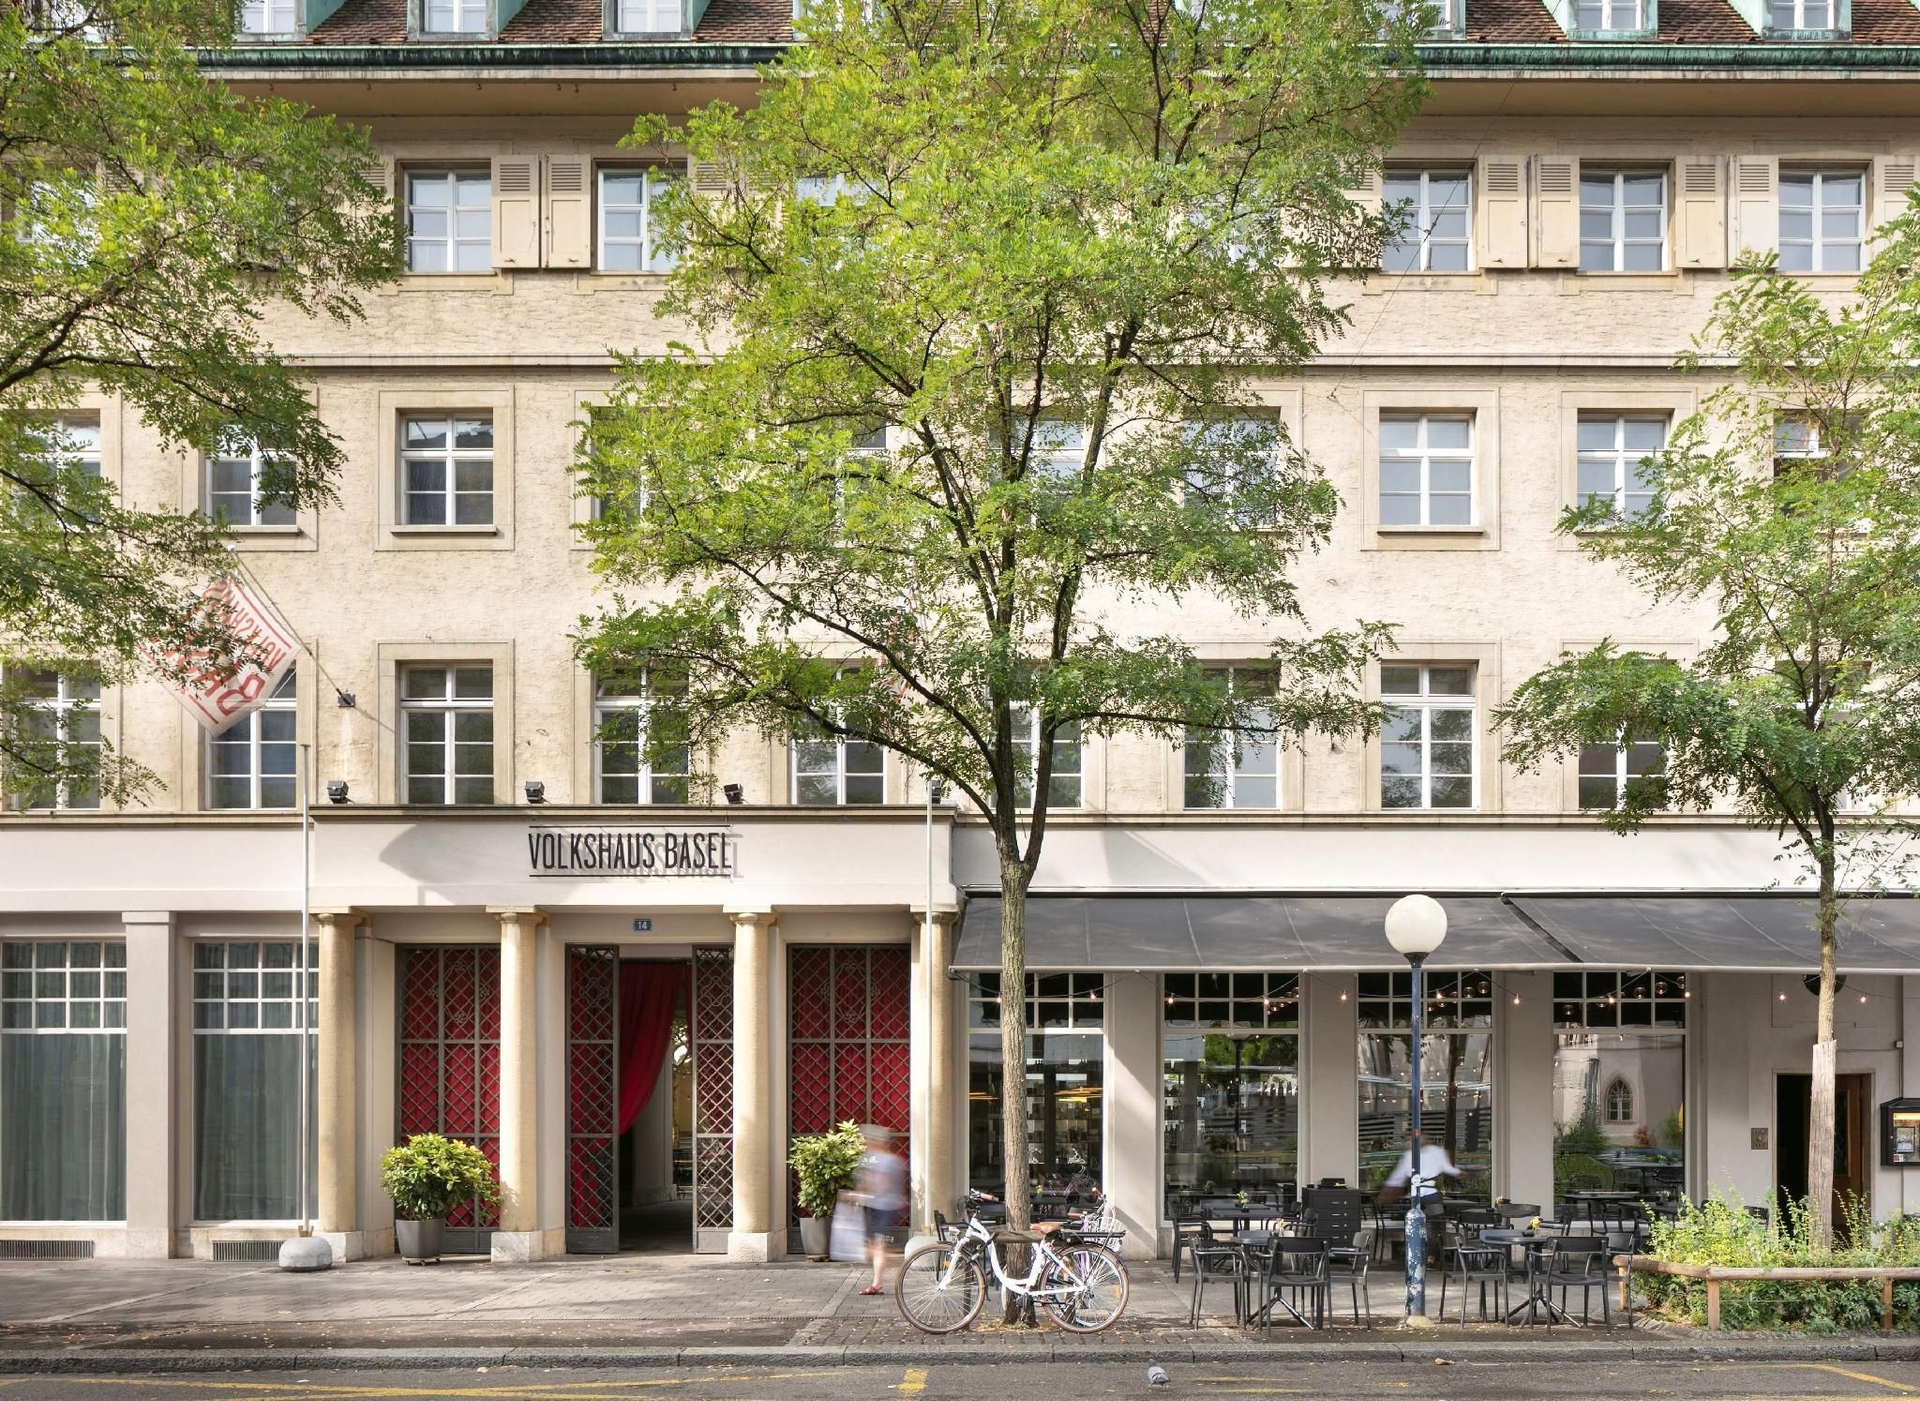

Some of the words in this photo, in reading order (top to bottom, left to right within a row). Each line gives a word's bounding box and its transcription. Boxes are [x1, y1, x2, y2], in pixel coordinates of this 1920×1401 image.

[528, 832, 655, 869] VOLKSHAUS
[664, 832, 732, 869] BASEL
[638, 921, 648, 930] 14
